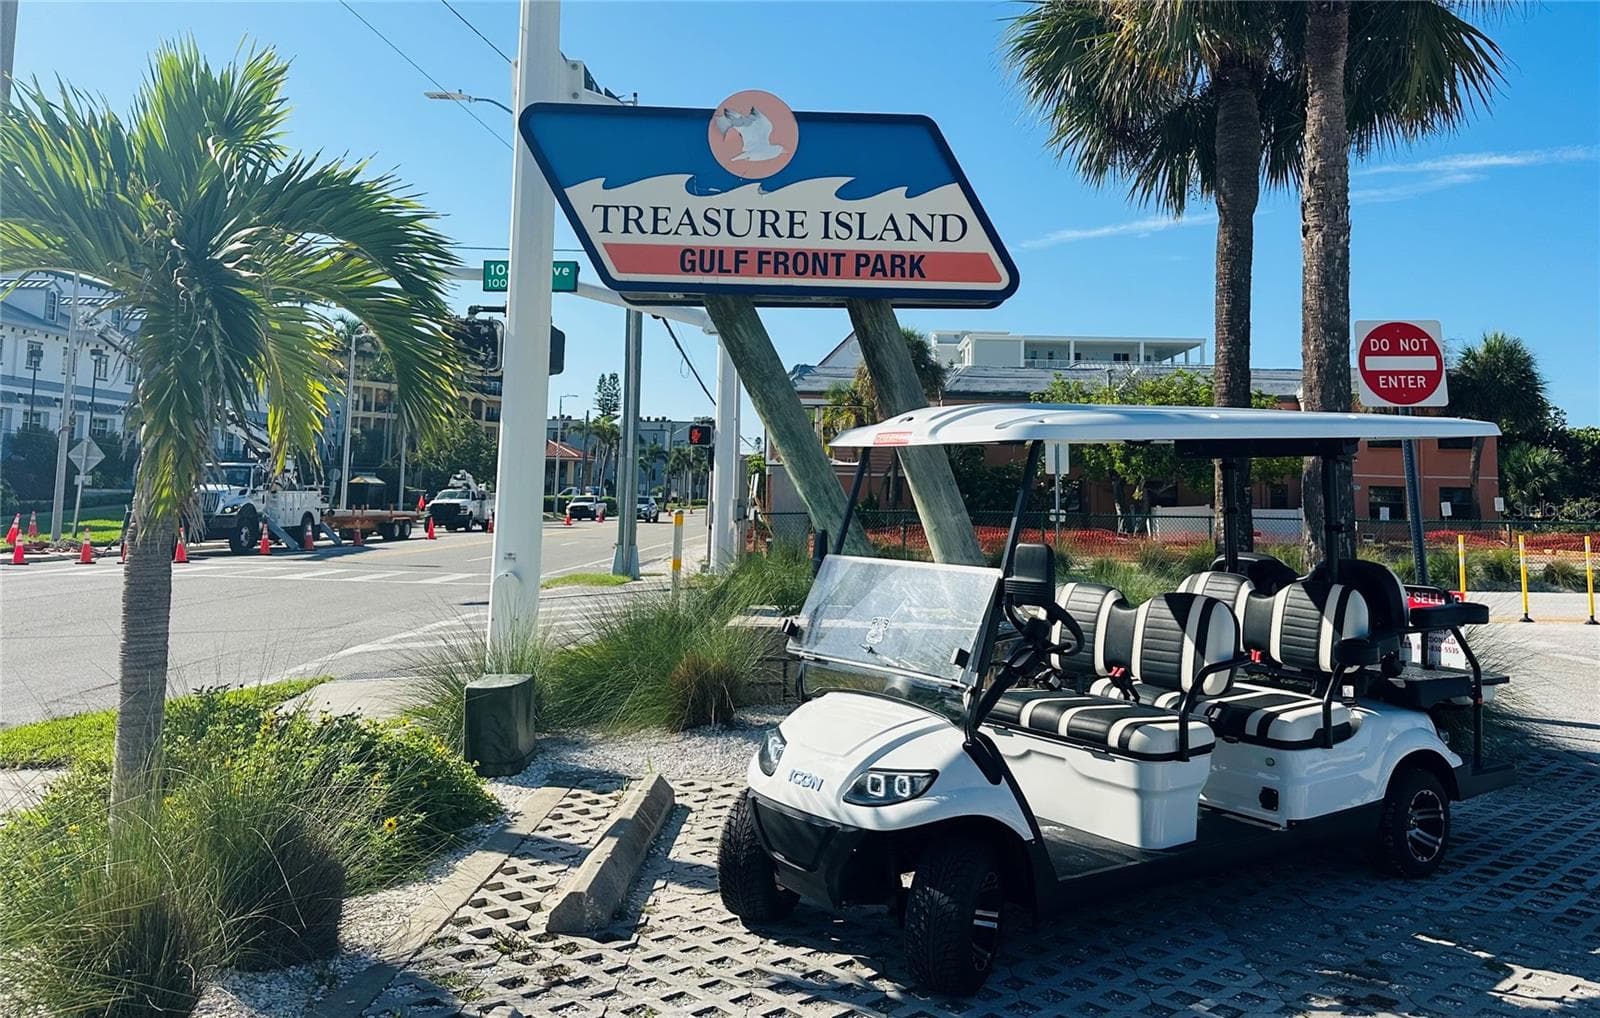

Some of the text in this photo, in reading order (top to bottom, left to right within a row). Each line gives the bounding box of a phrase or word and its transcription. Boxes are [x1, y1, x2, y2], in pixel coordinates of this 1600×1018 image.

[592, 204, 968, 243] TREASURE ISLAND
[490, 264, 570, 276] 10 ve
[680, 248, 926, 279] GULF FRONT PARK
[1370, 338, 1428, 351] DO NOT
[1379, 375, 1426, 388] ENTER
[789, 769, 824, 792] ICON
